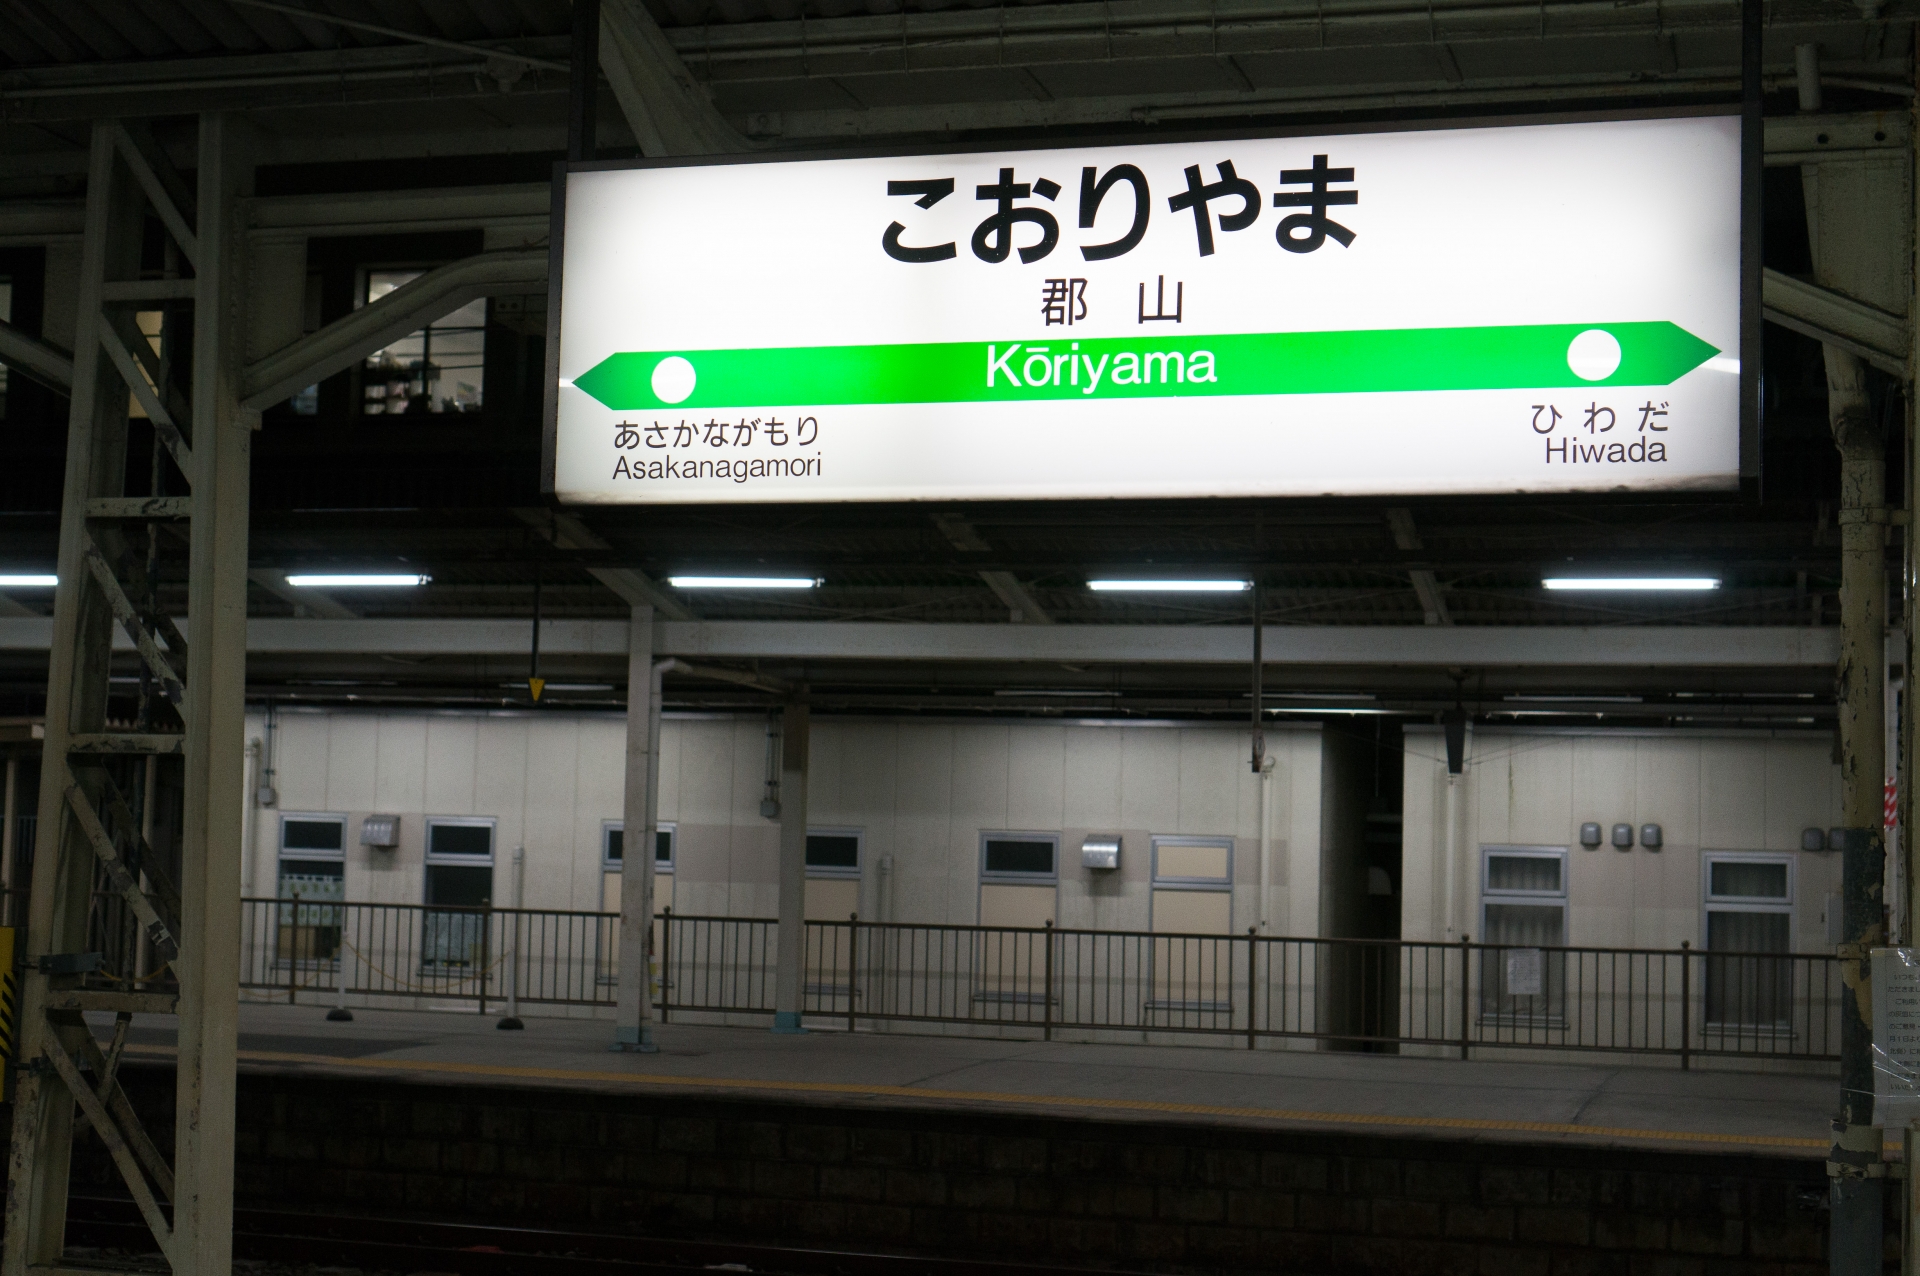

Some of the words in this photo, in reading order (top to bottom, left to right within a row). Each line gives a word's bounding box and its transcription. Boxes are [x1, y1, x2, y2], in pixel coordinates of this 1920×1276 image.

[882, 154, 1359, 265] こおりやま
[1041, 275, 1183, 326] 郡山
[987, 343, 1217, 395] Kōriyama
[614, 416, 818, 449] あさかながもり
[1532, 401, 1669, 434] ひわだ
[1546, 436, 1667, 463] Hiwada
[612, 452, 821, 483] Asakanagamori
